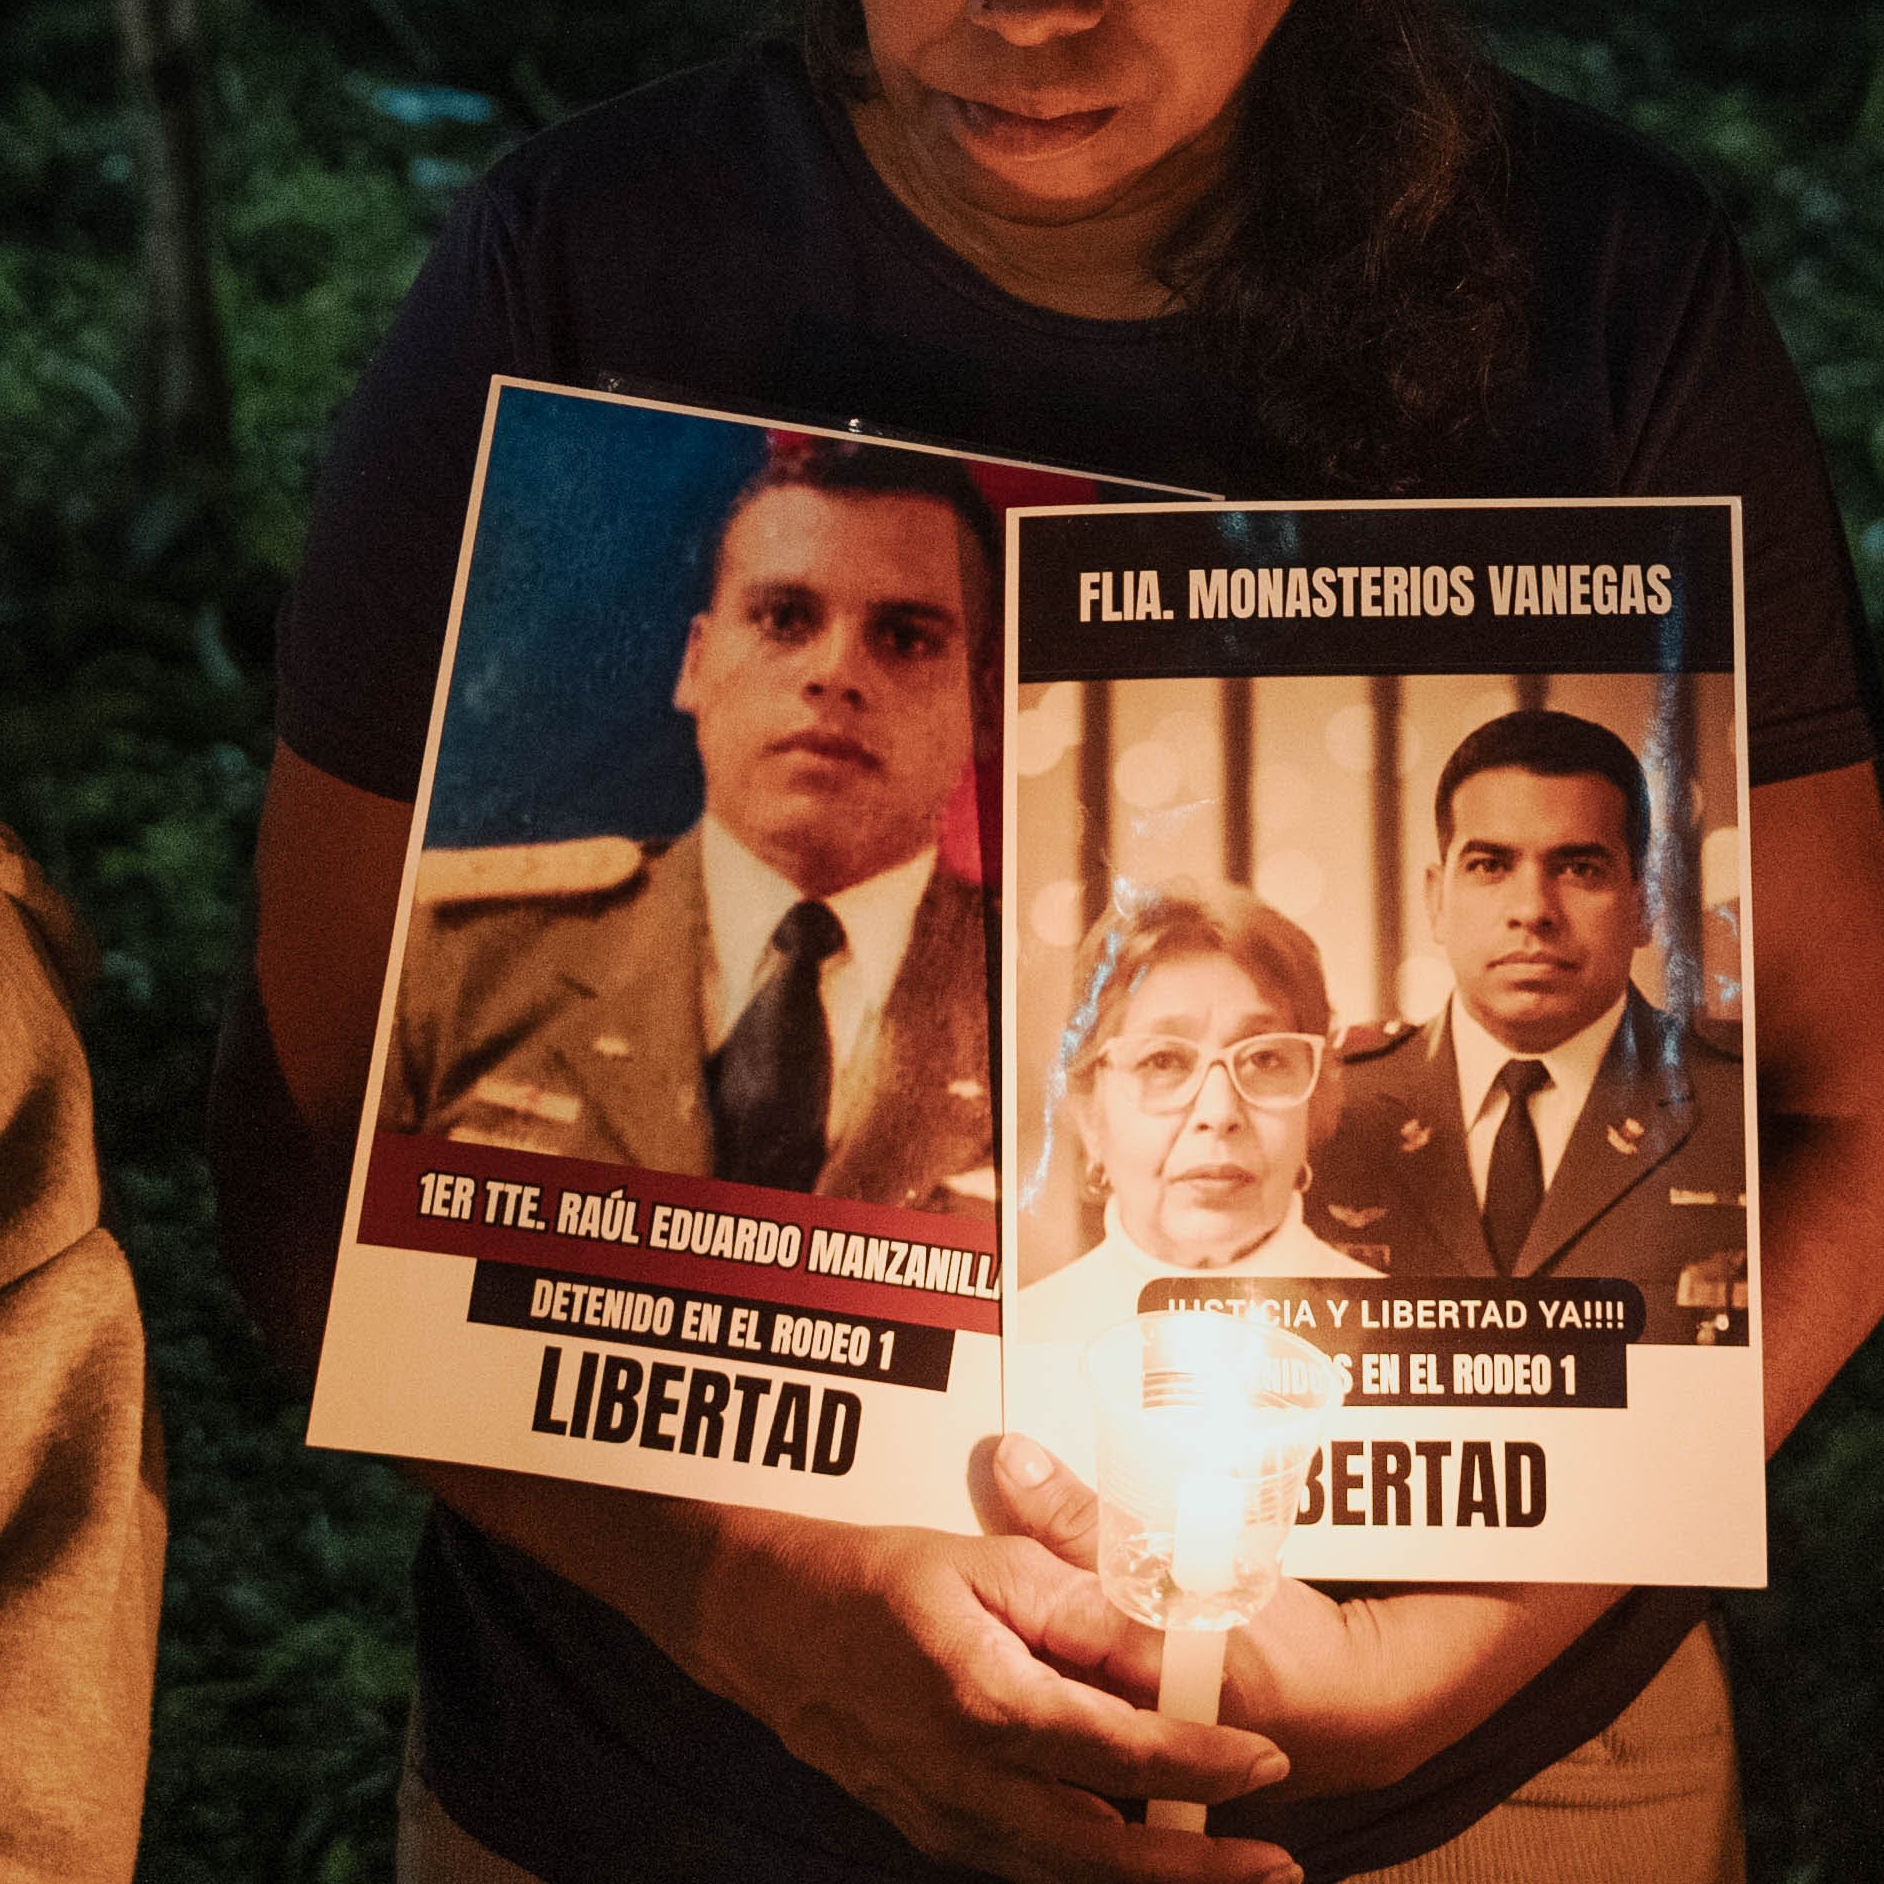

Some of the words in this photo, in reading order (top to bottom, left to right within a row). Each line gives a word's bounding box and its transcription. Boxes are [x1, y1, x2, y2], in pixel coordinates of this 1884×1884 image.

[1079, 570, 1174, 622] FLIA.
[1189, 565, 1476, 620] MONASTERIOS
[1487, 563, 1674, 616] VANEGAS
[419, 1172, 475, 1219] 1ER
[485, 1179, 546, 1231] TTE.
[557, 1188, 640, 1245] RAÚL
[649, 1205, 798, 1269] EDUARDO
[530, 1278, 673, 1337] DETENIDO
[682, 1300, 722, 1345] EN
[728, 1307, 763, 1351] EL
[770, 1312, 868, 1367] RODEO
[876, 1329, 895, 1370] 1
[1326, 1298, 1350, 1329] Y
[1360, 1298, 1528, 1330] LIBERTAD
[1540, 1299, 1626, 1330] YA!!!!
[531, 1346, 864, 1477] LIBERTAD
[1363, 1352, 1400, 1395] EN
[1409, 1353, 1445, 1395] EL
[1453, 1353, 1552, 1396] RODEO
[1559, 1354, 1576, 1396] 1
[1288, 1440, 1548, 1529] BERTAD
